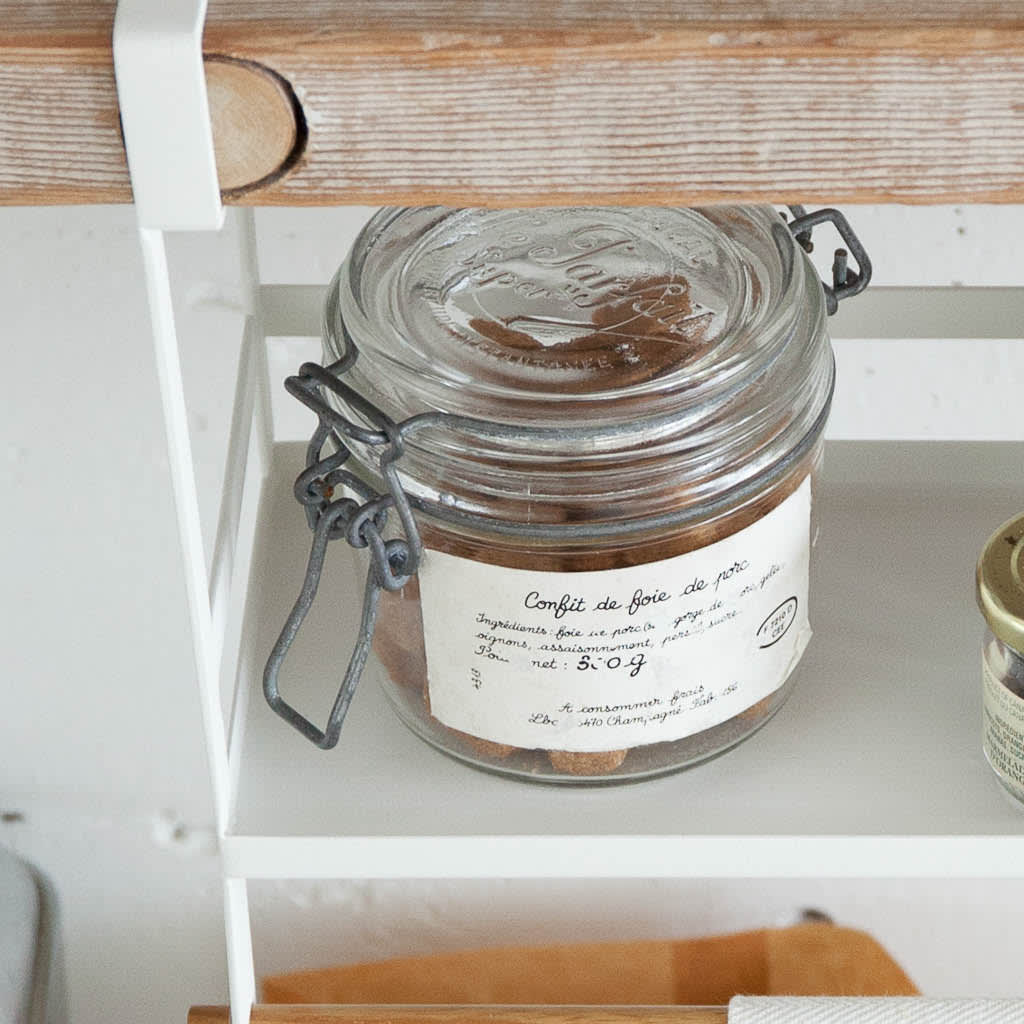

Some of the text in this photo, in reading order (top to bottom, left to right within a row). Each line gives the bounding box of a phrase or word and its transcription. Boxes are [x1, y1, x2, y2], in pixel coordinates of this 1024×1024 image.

[524, 559, 751, 618] Confit de foie de porc
[554, 626, 584, 641] foie
[577, 697, 661, 714] consommer
